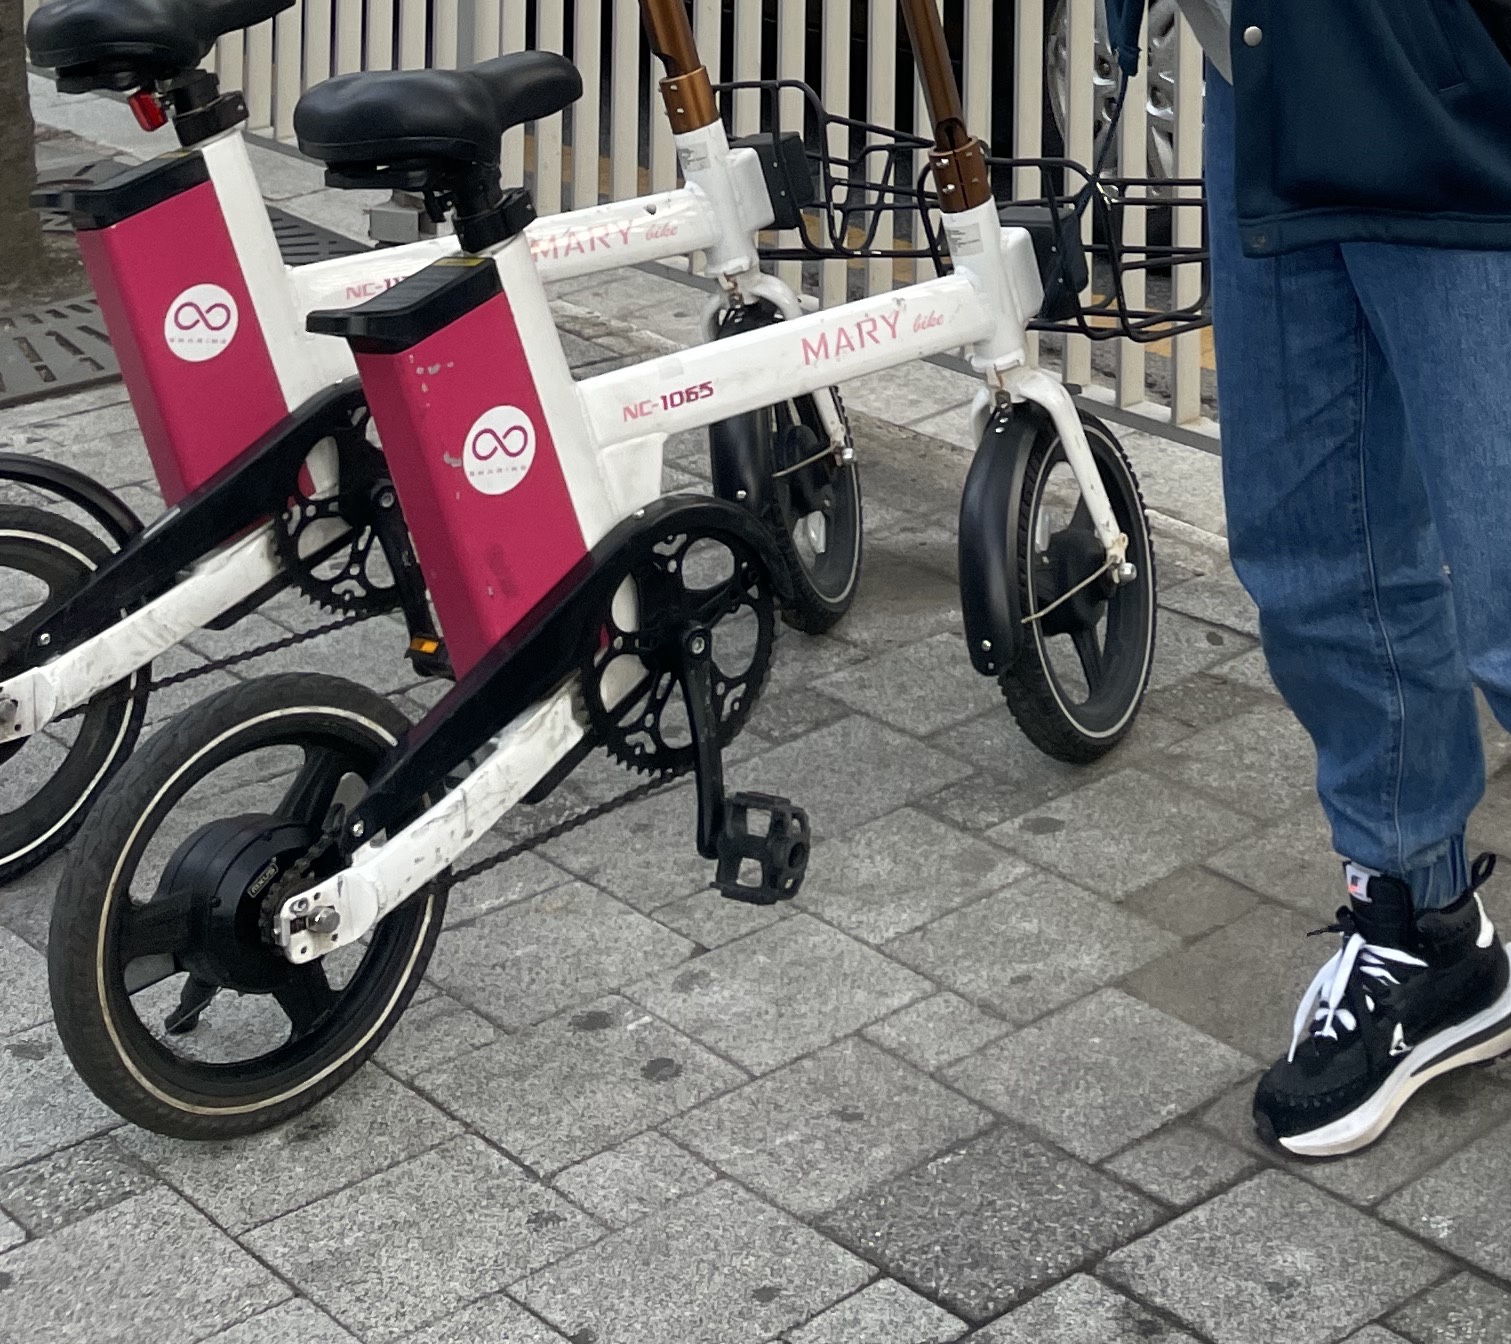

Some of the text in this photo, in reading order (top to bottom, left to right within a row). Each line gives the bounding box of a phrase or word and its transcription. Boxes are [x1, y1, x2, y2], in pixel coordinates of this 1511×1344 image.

[530, 219, 678, 263] MARY bike
[801, 310, 944, 366] MARY bike
[622, 380, 714, 423] NC-1065
